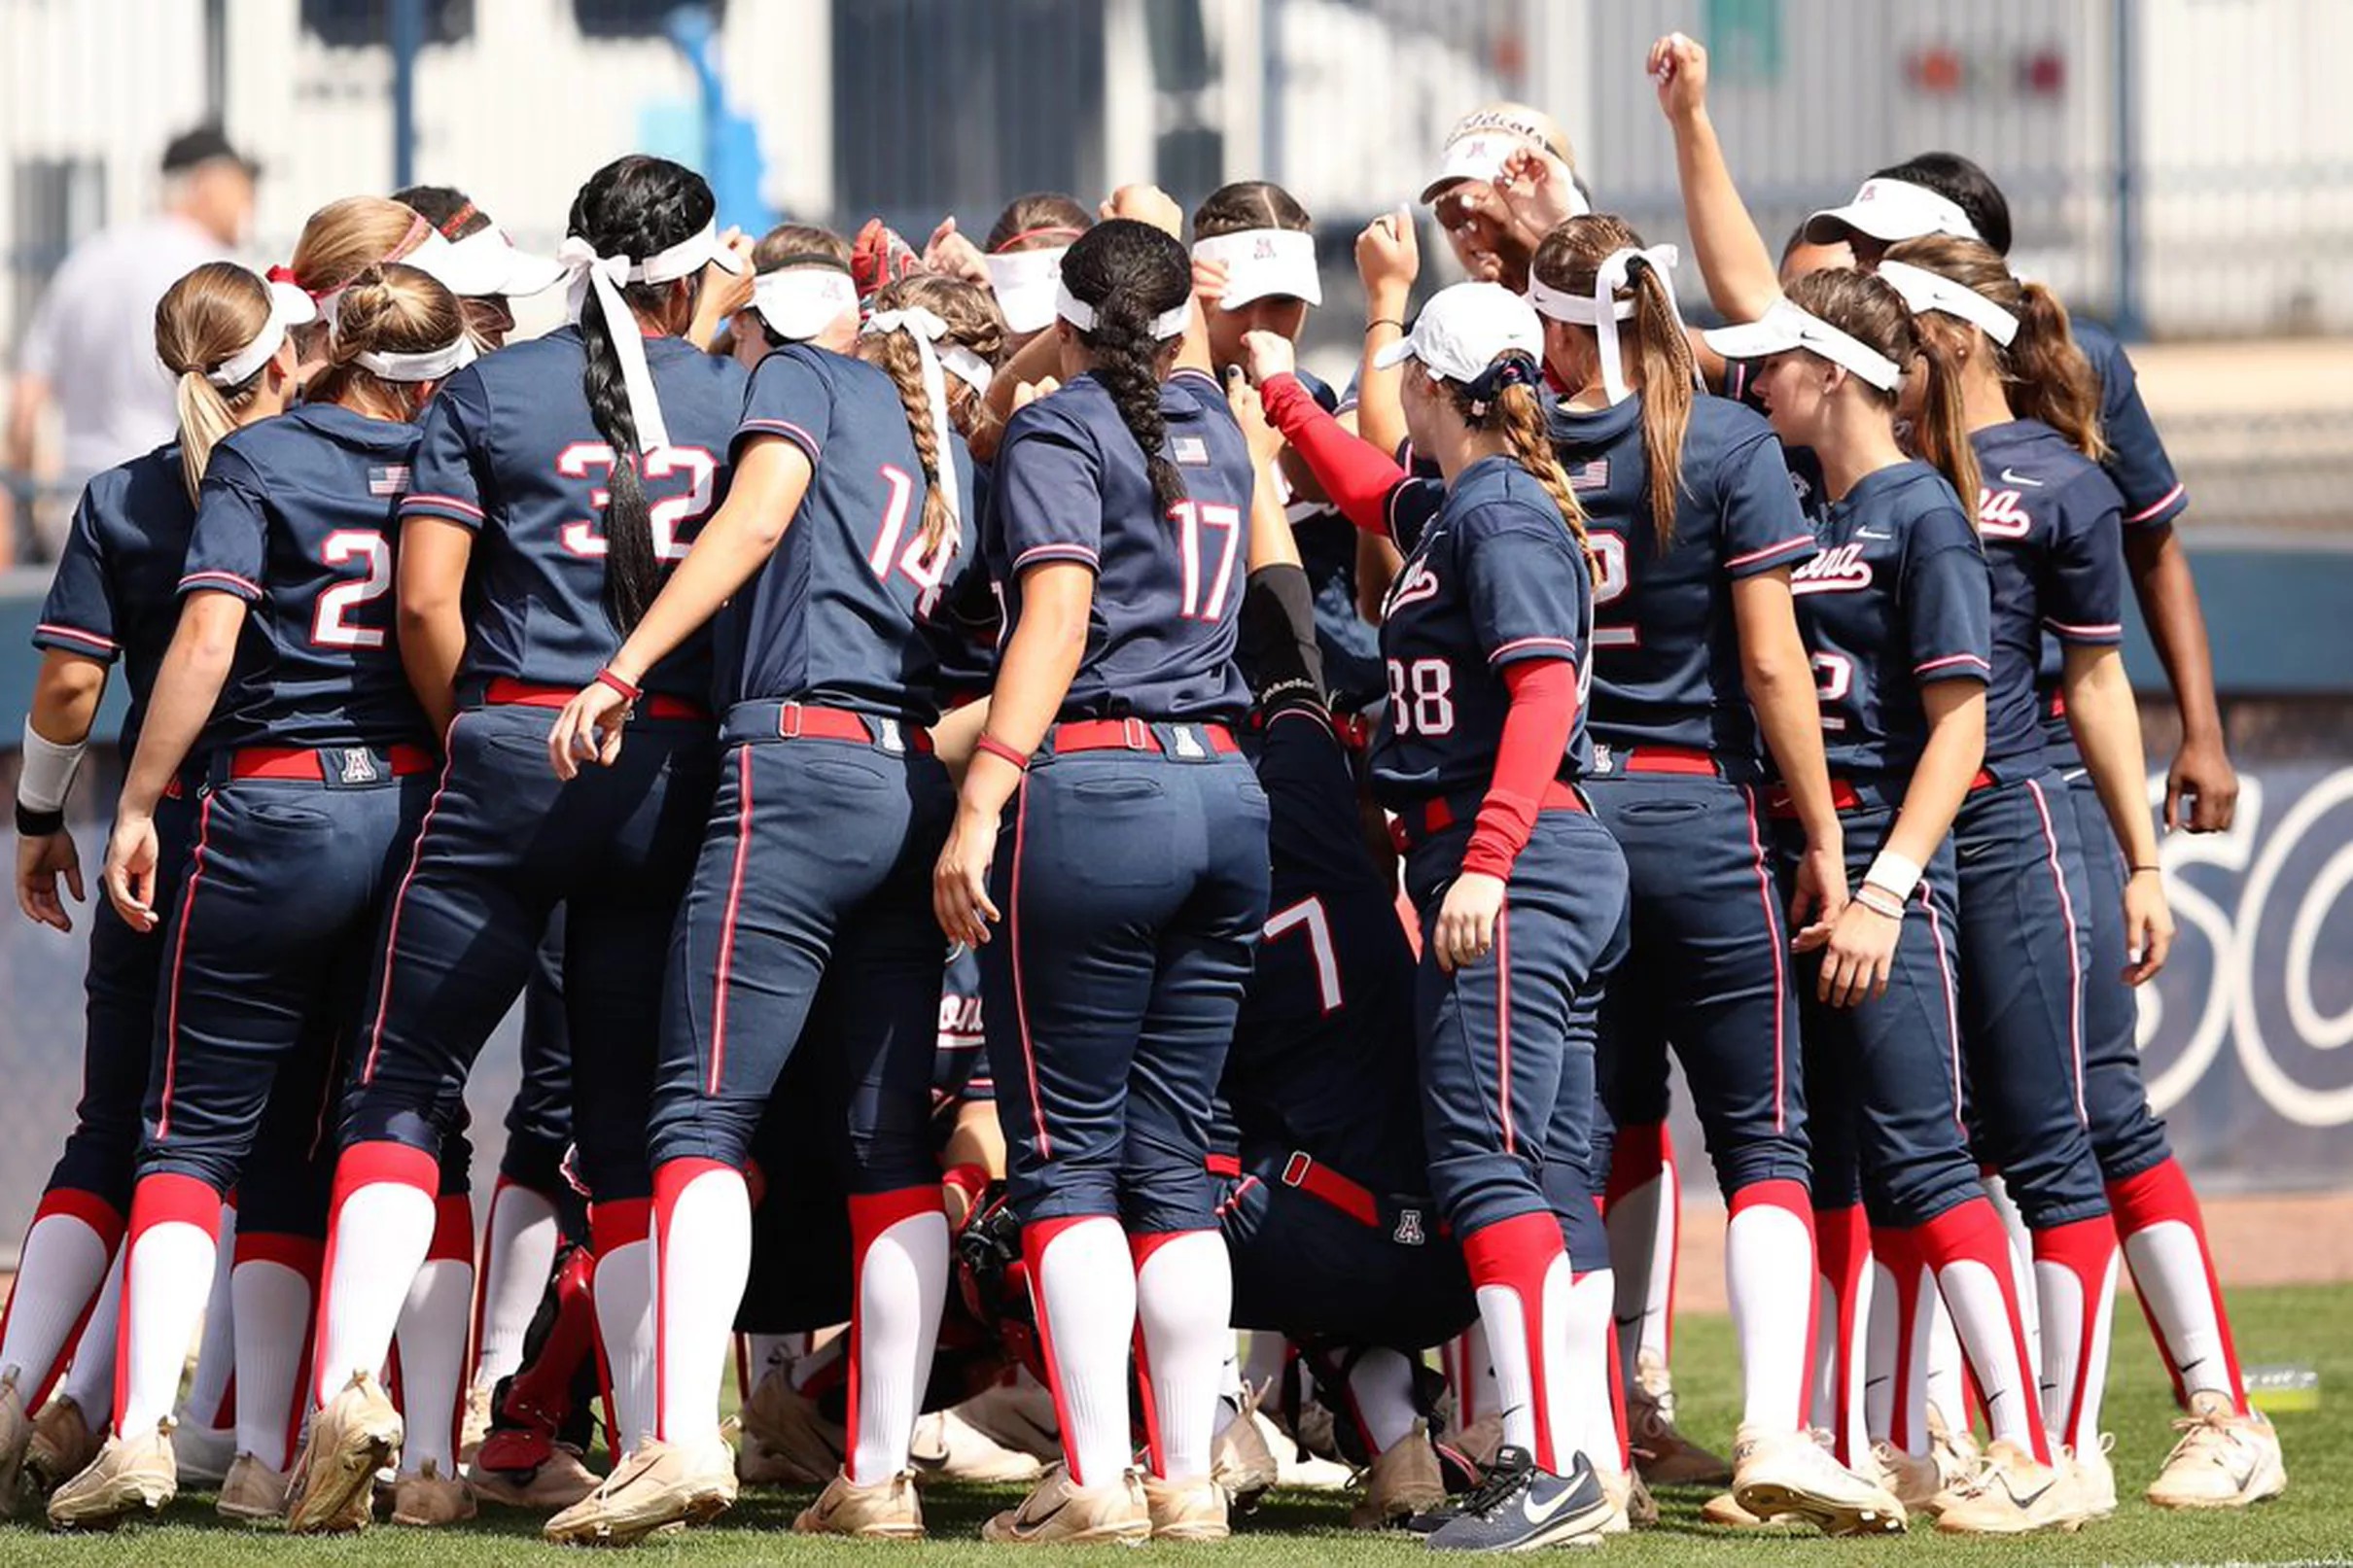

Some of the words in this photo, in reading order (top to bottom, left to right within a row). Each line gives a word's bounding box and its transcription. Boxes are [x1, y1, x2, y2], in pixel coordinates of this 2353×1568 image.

[555, 441, 721, 562] 32
[869, 462, 963, 624] 14
[1169, 500, 1241, 623] 17
[310, 528, 391, 648] 2
[341, 747, 377, 784] A
[1263, 893, 1346, 1018] 7
[1393, 1209, 1425, 1245] A
